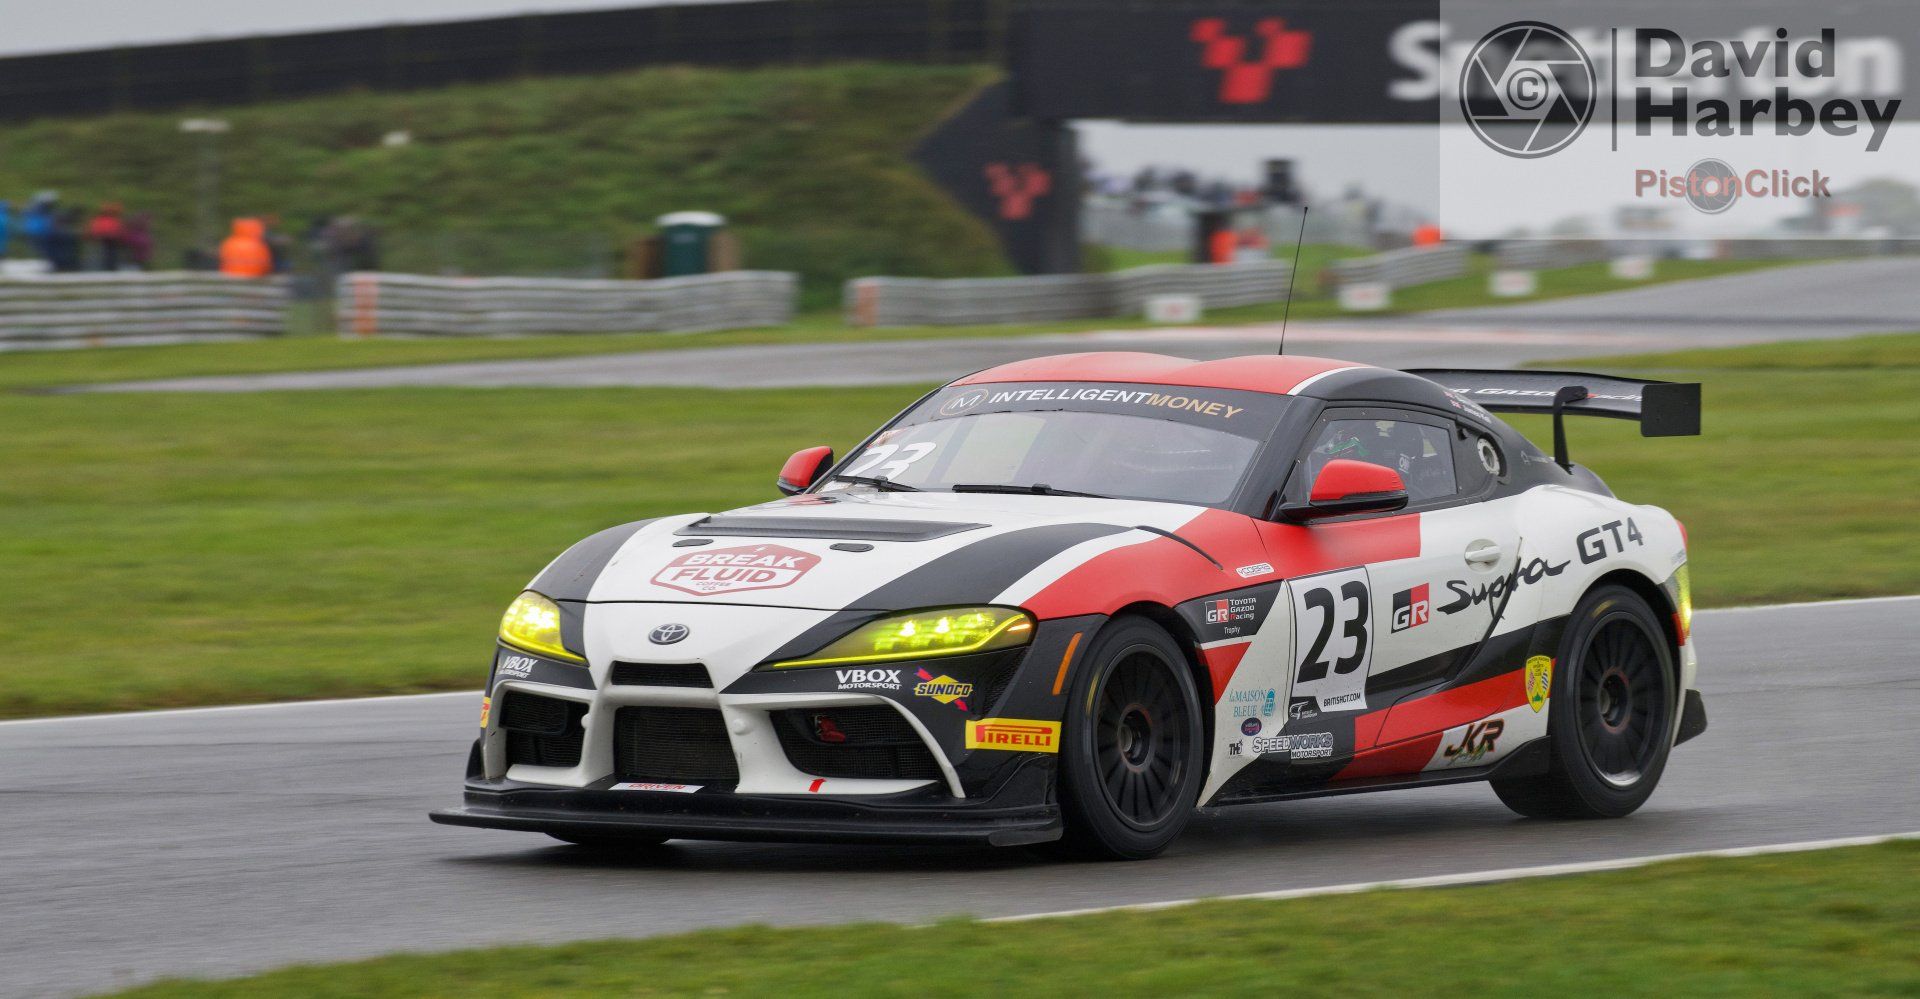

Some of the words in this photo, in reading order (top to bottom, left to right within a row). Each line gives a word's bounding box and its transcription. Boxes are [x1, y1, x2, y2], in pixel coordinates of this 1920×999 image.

[1474, 387, 1556, 397] GAZO
[682, 553, 806, 568] BREAK
[1437, 555, 1571, 620] Supra
[1576, 516, 1644, 565] GT4
[671, 567, 777, 583] FLUID
[1230, 597, 1257, 606] TOYOTA
[1230, 605, 1255, 613] GAZOO
[1207, 609, 1228, 622] GR
[1393, 599, 1428, 631] GR
[1296, 580, 1369, 684] 23
[502, 655, 538, 673] VBOX
[835, 669, 902, 684] VBOX
[837, 682, 903, 691] MOTORSPORT
[916, 683, 973, 697] SUNOCO
[1233, 704, 1258, 718] BLEUE
[975, 724, 1053, 747] PIRELLI
[1252, 732, 1334, 754] SPEEDWORKS
[1290, 748, 1332, 760] MOTORSPORT
